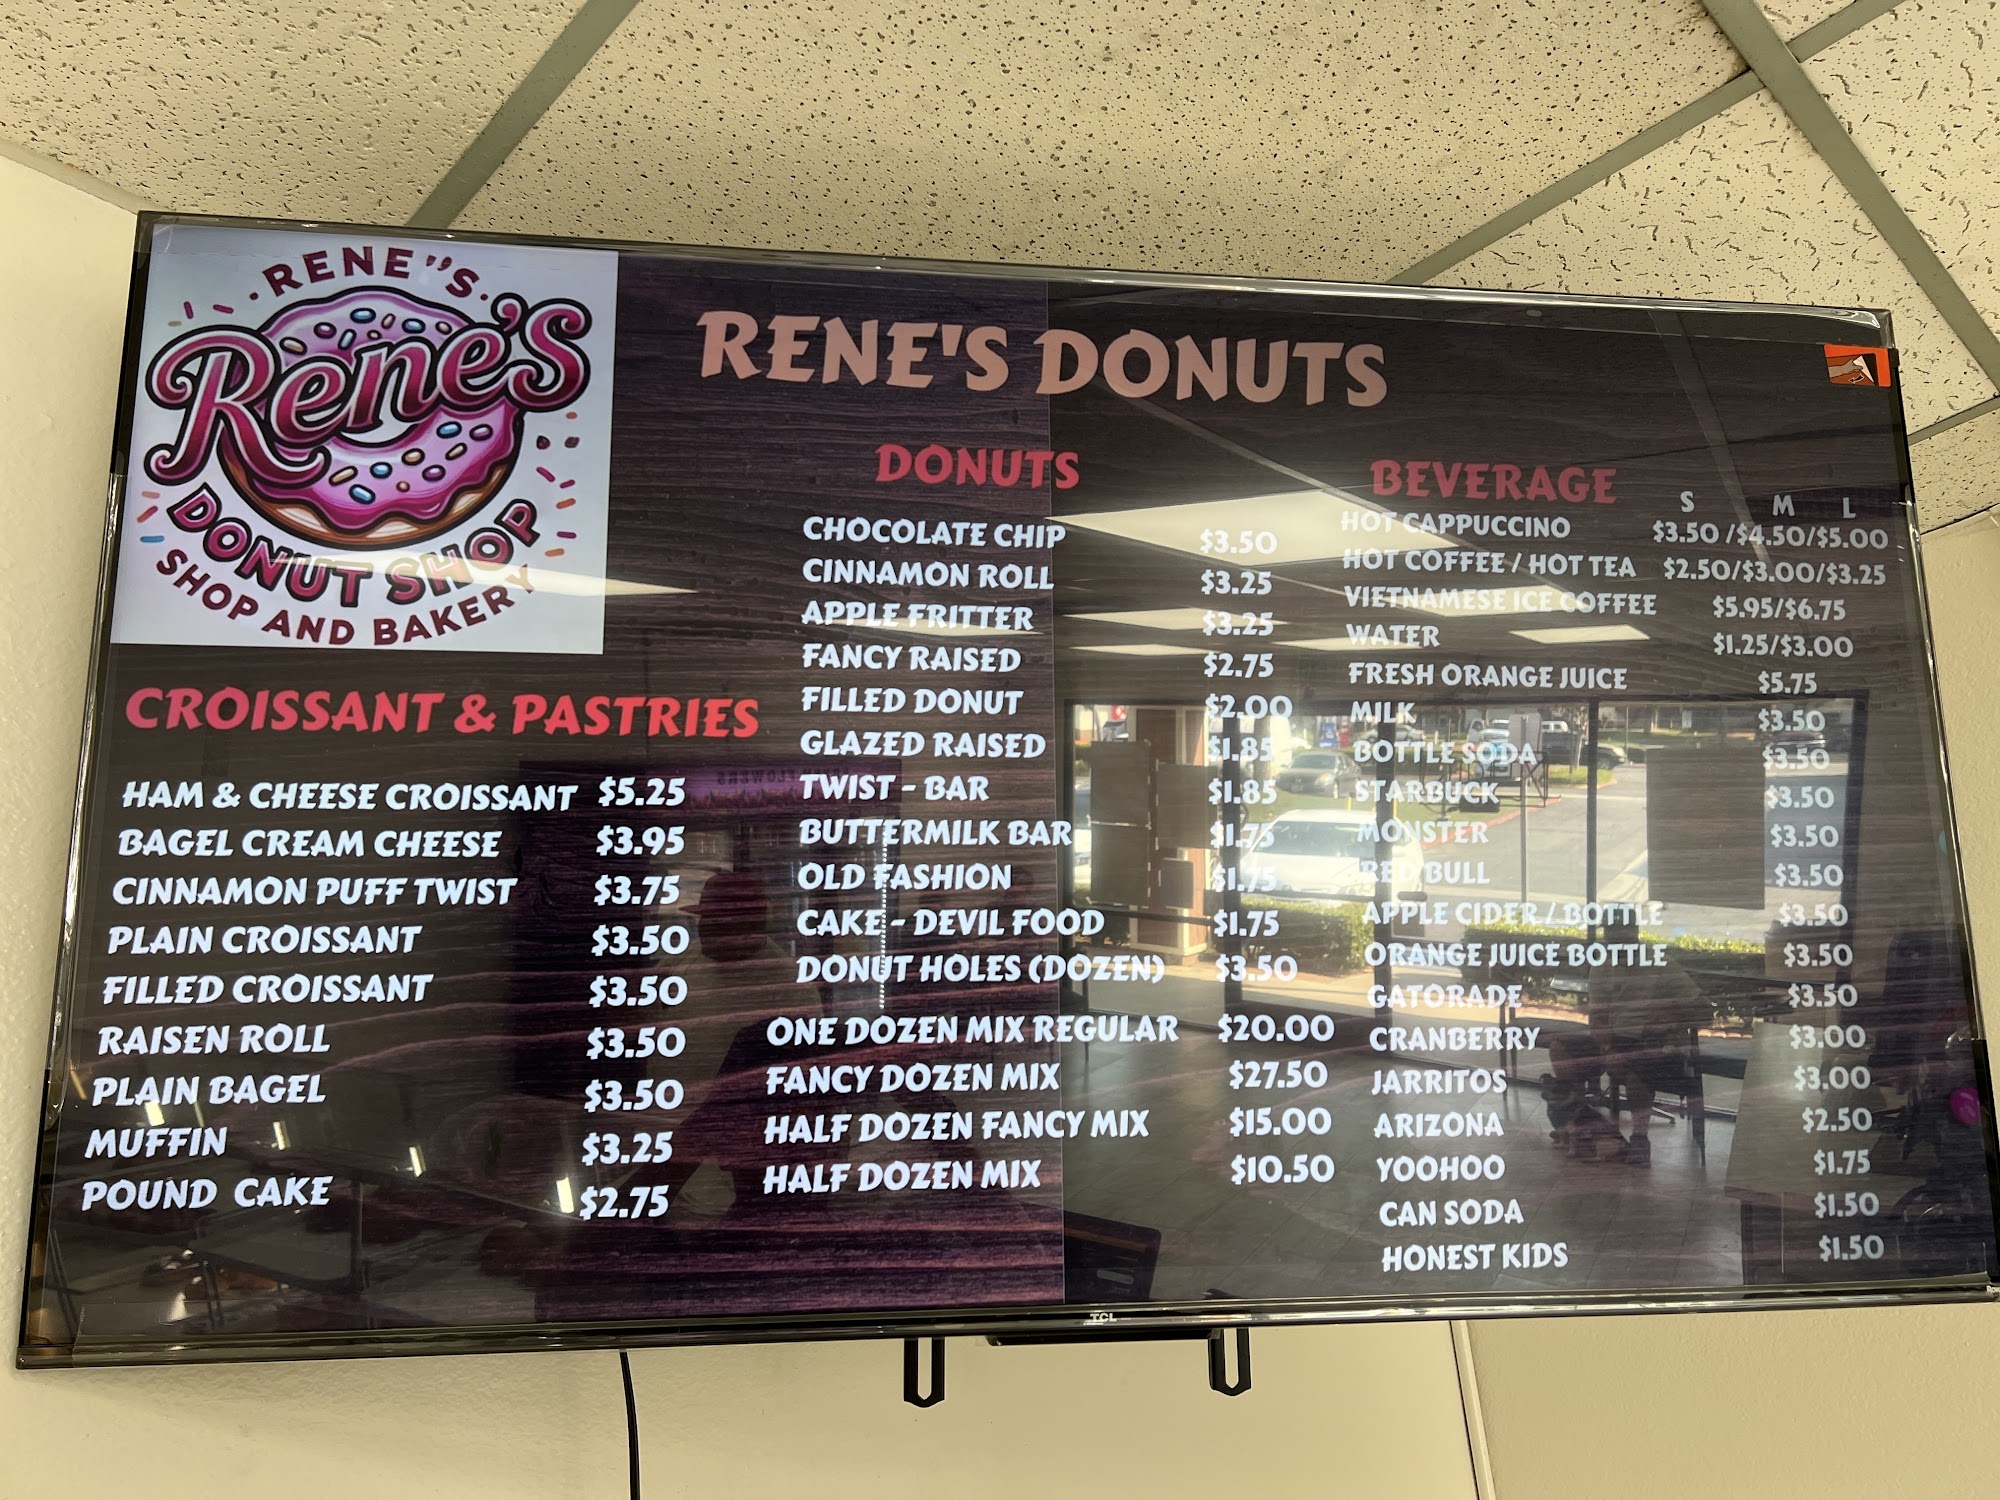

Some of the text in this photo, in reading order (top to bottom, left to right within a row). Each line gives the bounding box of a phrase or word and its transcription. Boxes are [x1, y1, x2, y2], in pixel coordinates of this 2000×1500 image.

[696, 311, 1388, 407] RENE'S DONUTS
[875, 444, 1080, 490] DONUTS
[1370, 460, 1617, 505] BEVERAGE
[1680, 491, 1856, 519] S M L
[803, 516, 1277, 556] CHOCOLATE CHIP $3.50
[1342, 512, 1397, 534] HOT
[1403, 513, 1571, 539] CAPPUCCINO
[1652, 520, 1719, 545] $3.50
[168, 484, 541, 607] DONUT SHOP
[803, 558, 1273, 597] CINNAMON ROLL $3.25
[1343, 549, 1887, 587] HOT COFFEE HOT TEA $2.50/$3.00/$3.25
[155, 548, 536, 645] SHOP AND BAKERY
[1344, 585, 1846, 621] VIETNAMESE ICE COFFEE $5.95/$6.75
[801, 600, 1274, 637] APPLE FRITTER $3.25
[1346, 624, 1853, 657] WATER $1.25/$3.00
[802, 644, 1274, 679] FANCY RAISED $2.75
[1349, 662, 1817, 694] FRESH ORANGE JUICE $5.75
[126, 687, 759, 738] CROISSANT & PASTRIES
[801, 686, 1293, 721] FILLED DONUT $2.00
[1350, 702, 1825, 732] MILK $3.50
[801, 730, 1046, 759] GLAZED RAISED
[1354, 742, 1537, 766] BOTTLE SODA
[122, 777, 686, 811] HAM CHEESE CROISSANT $5.25
[801, 775, 1277, 805] TWIST BAR $1.85
[1356, 781, 1834, 809] STARBUCK $3.50
[117, 826, 685, 858] BAGEL CREAM CHEESE $3.95
[799, 819, 1073, 846] BUTTERMILK BAR
[1357, 820, 1839, 848] MONSTER $3.50
[112, 875, 680, 906] CINNAMON PUFF TWIST $3.75
[798, 863, 1012, 890] OLD FASHION
[1425, 861, 1844, 888] BULL $3.50
[797, 908, 1279, 937] CAKE DEVIL FOOD $1.75
[1363, 902, 1848, 927] APPLE CIDER BOTTLE $3.50
[107, 925, 689, 956] PLAIN CROISSANT $3.50
[1365, 943, 1853, 968] ORANGE JUICE BOTTLE $3.50
[796, 954, 1298, 984] DONUT HOLES (DOZEN) $3.50
[102, 974, 687, 1008] FILLED CROISSANT $3.50
[1367, 984, 1858, 1009] GATORADE $3.50
[98, 1024, 686, 1059] RAISEN ROLL $3.50
[767, 1014, 1334, 1046] ONE DOZEN MIX REGULAR $20.00
[1370, 1024, 1866, 1052] CRANBERRY $3.00
[92, 1075, 684, 1112] PLAIN BAGEL $3.50
[766, 1060, 1328, 1096] FANCY DOZEN MIX $27.50
[1372, 1066, 1871, 1096] JARRITOS $3.00
[764, 1107, 1332, 1145] HALF DOZEN FANCY MIX $15.00
[1374, 1107, 1873, 1139] ARIZONA $2.50
[85, 1128, 673, 1166] MUFFIN $3.25
[763, 1155, 1334, 1195] HALF DOZEN MIX $10.50
[1377, 1150, 1870, 1183] YOOHOO $1.75
[81, 1177, 669, 1220] POUND CAKE $2.75
[1380, 1192, 1880, 1227] CAN SODA $1.50
[1382, 1235, 1884, 1272] HONEST KIDS $1.50
[1090, 1313, 1117, 1322] TCL
